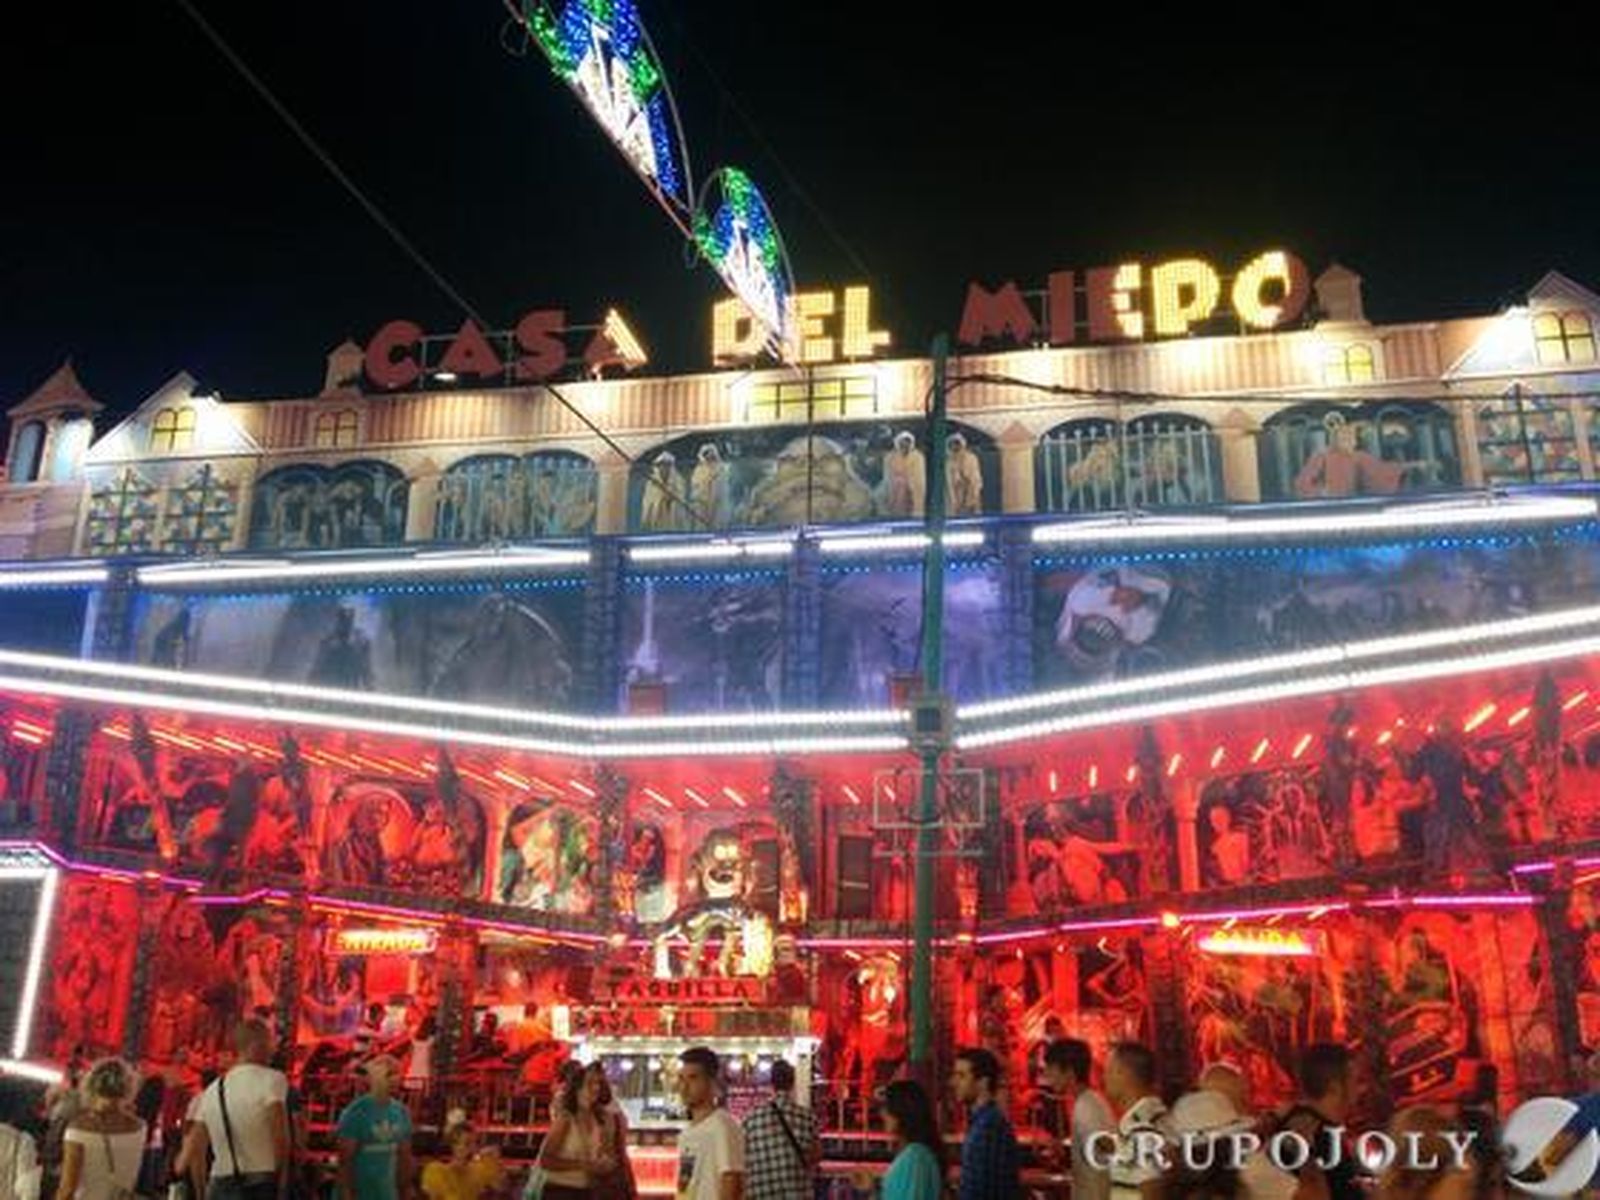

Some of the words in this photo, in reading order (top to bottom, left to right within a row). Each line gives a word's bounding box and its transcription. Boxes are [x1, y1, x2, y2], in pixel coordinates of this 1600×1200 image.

[363, 307, 647, 388] CASA
[713, 286, 890, 367] DEL
[608, 980, 749, 998] TAQUILLA
